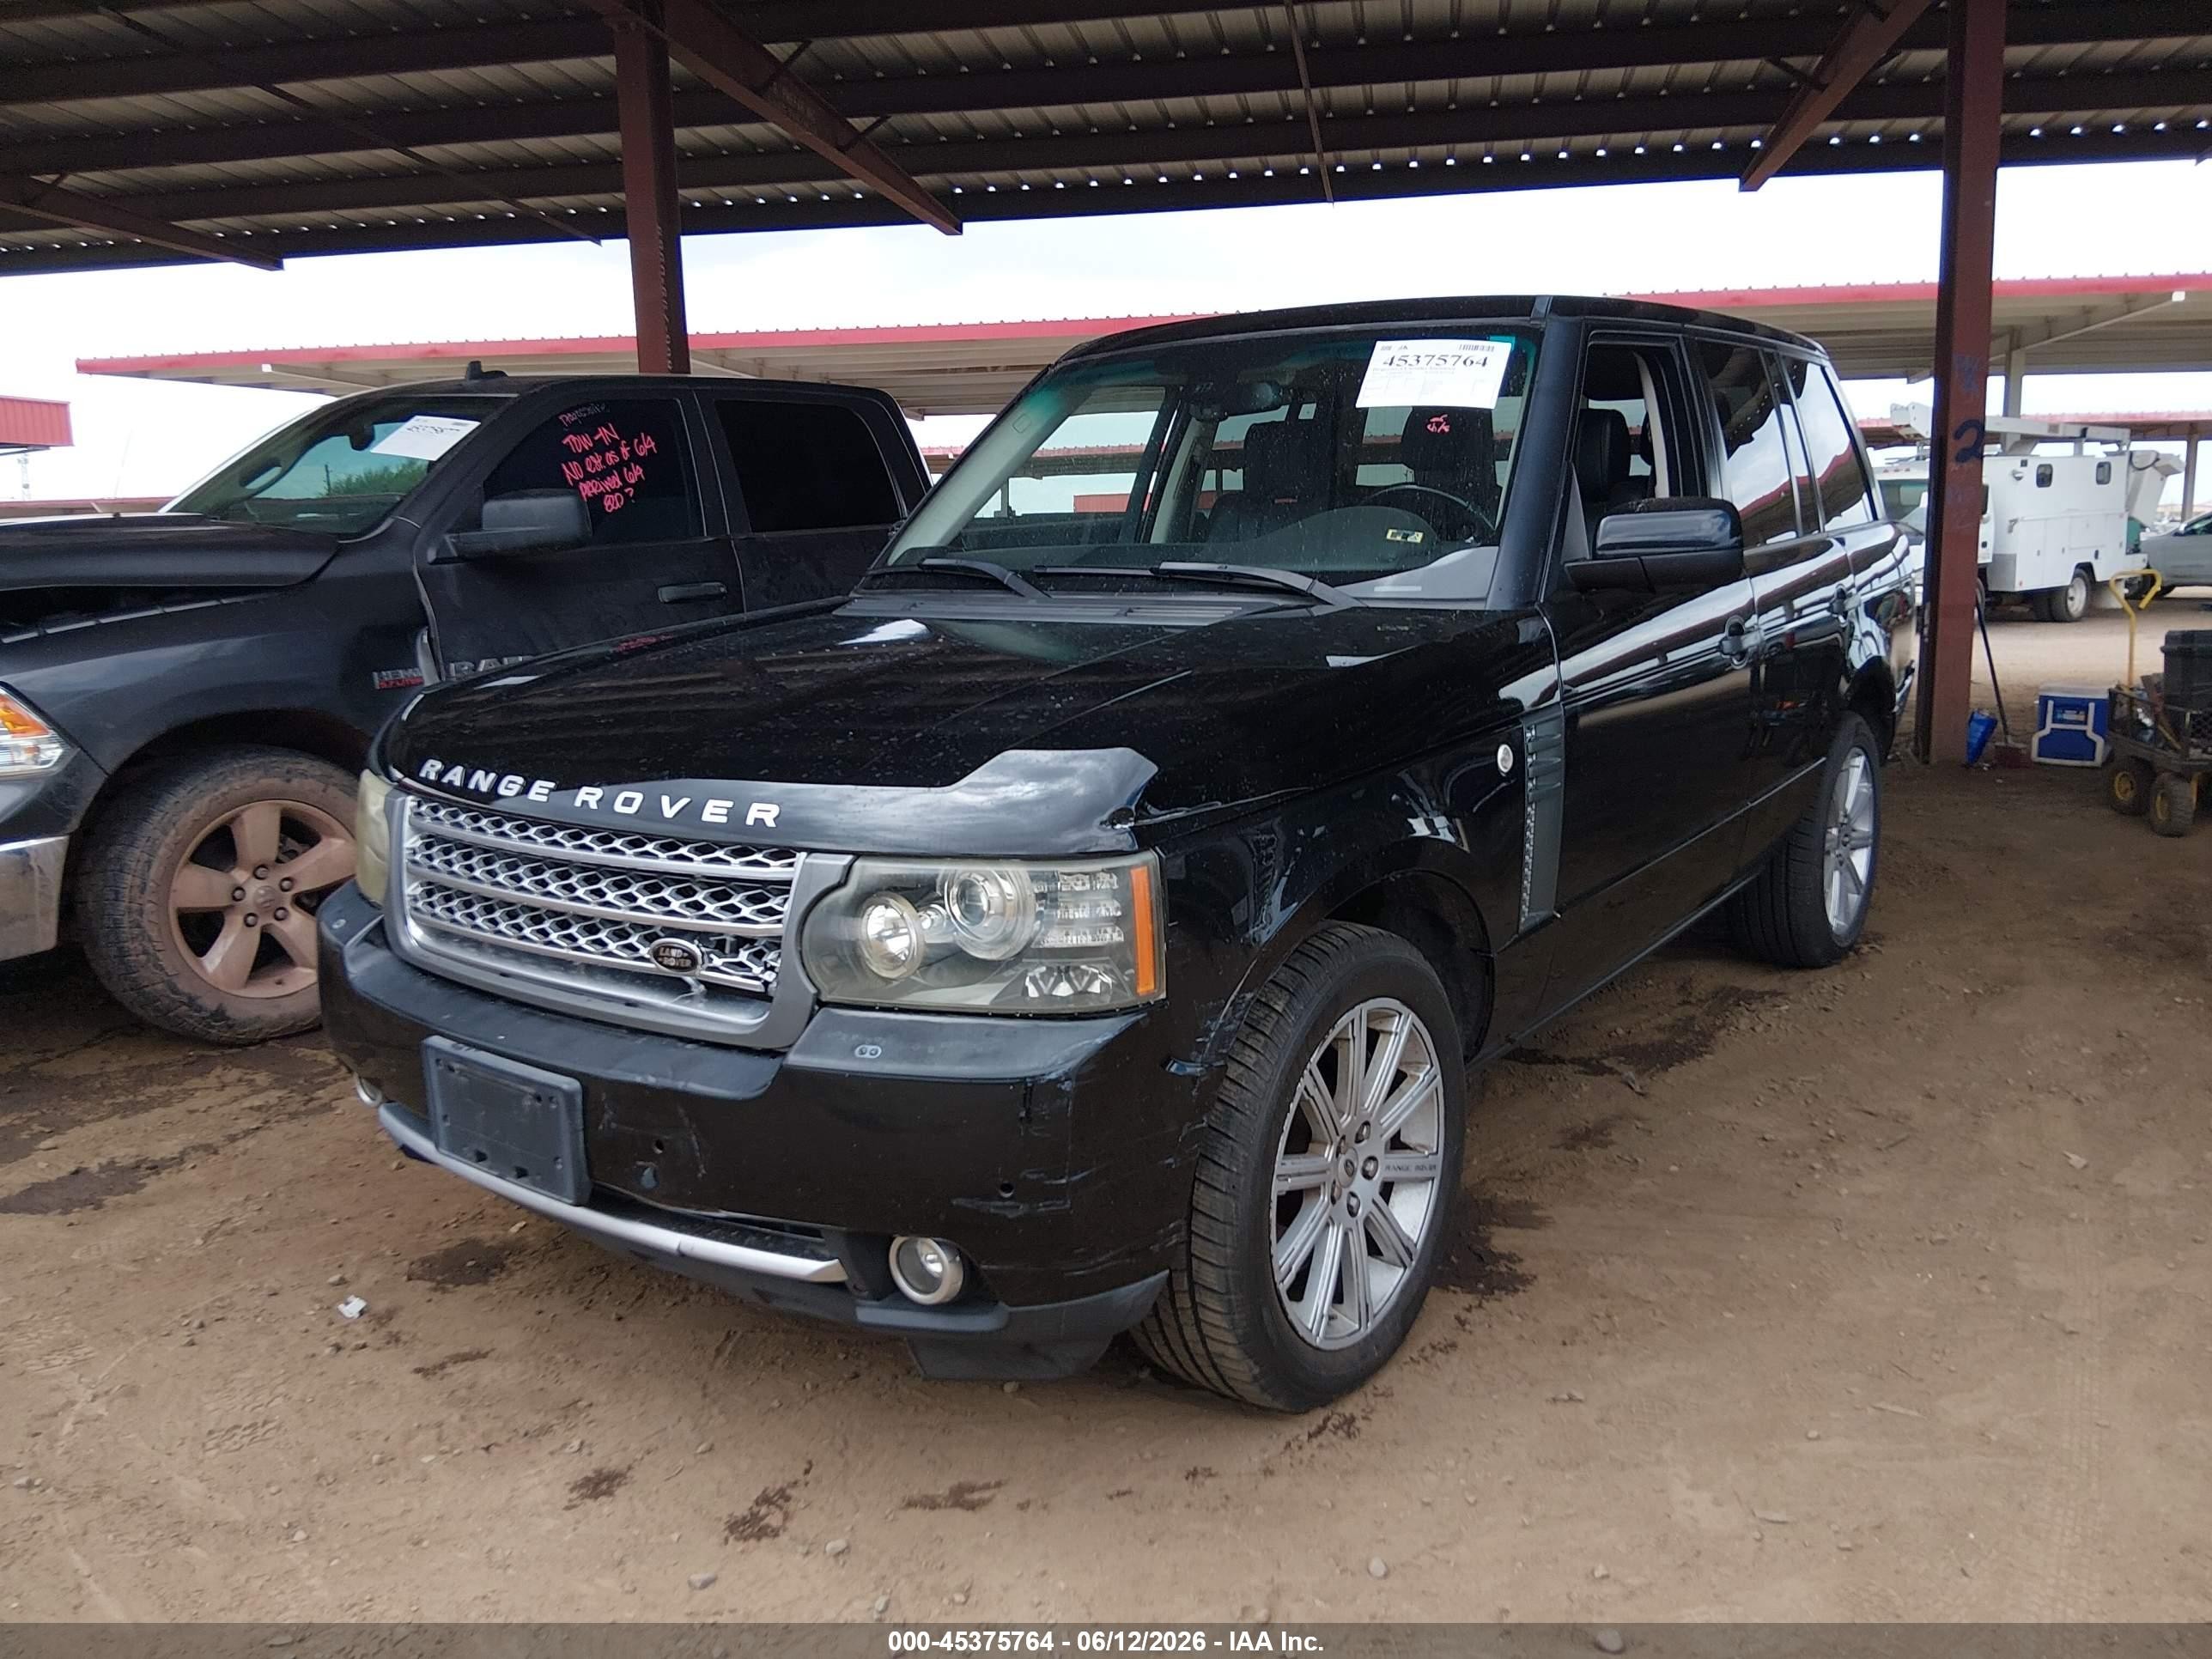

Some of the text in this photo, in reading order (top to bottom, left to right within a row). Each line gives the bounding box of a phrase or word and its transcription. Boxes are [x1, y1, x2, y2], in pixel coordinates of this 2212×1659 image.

[1382, 354, 1489, 368] 45375764
[1953, 419, 1986, 463] 2
[419, 758, 781, 829] RANGE ROVER
